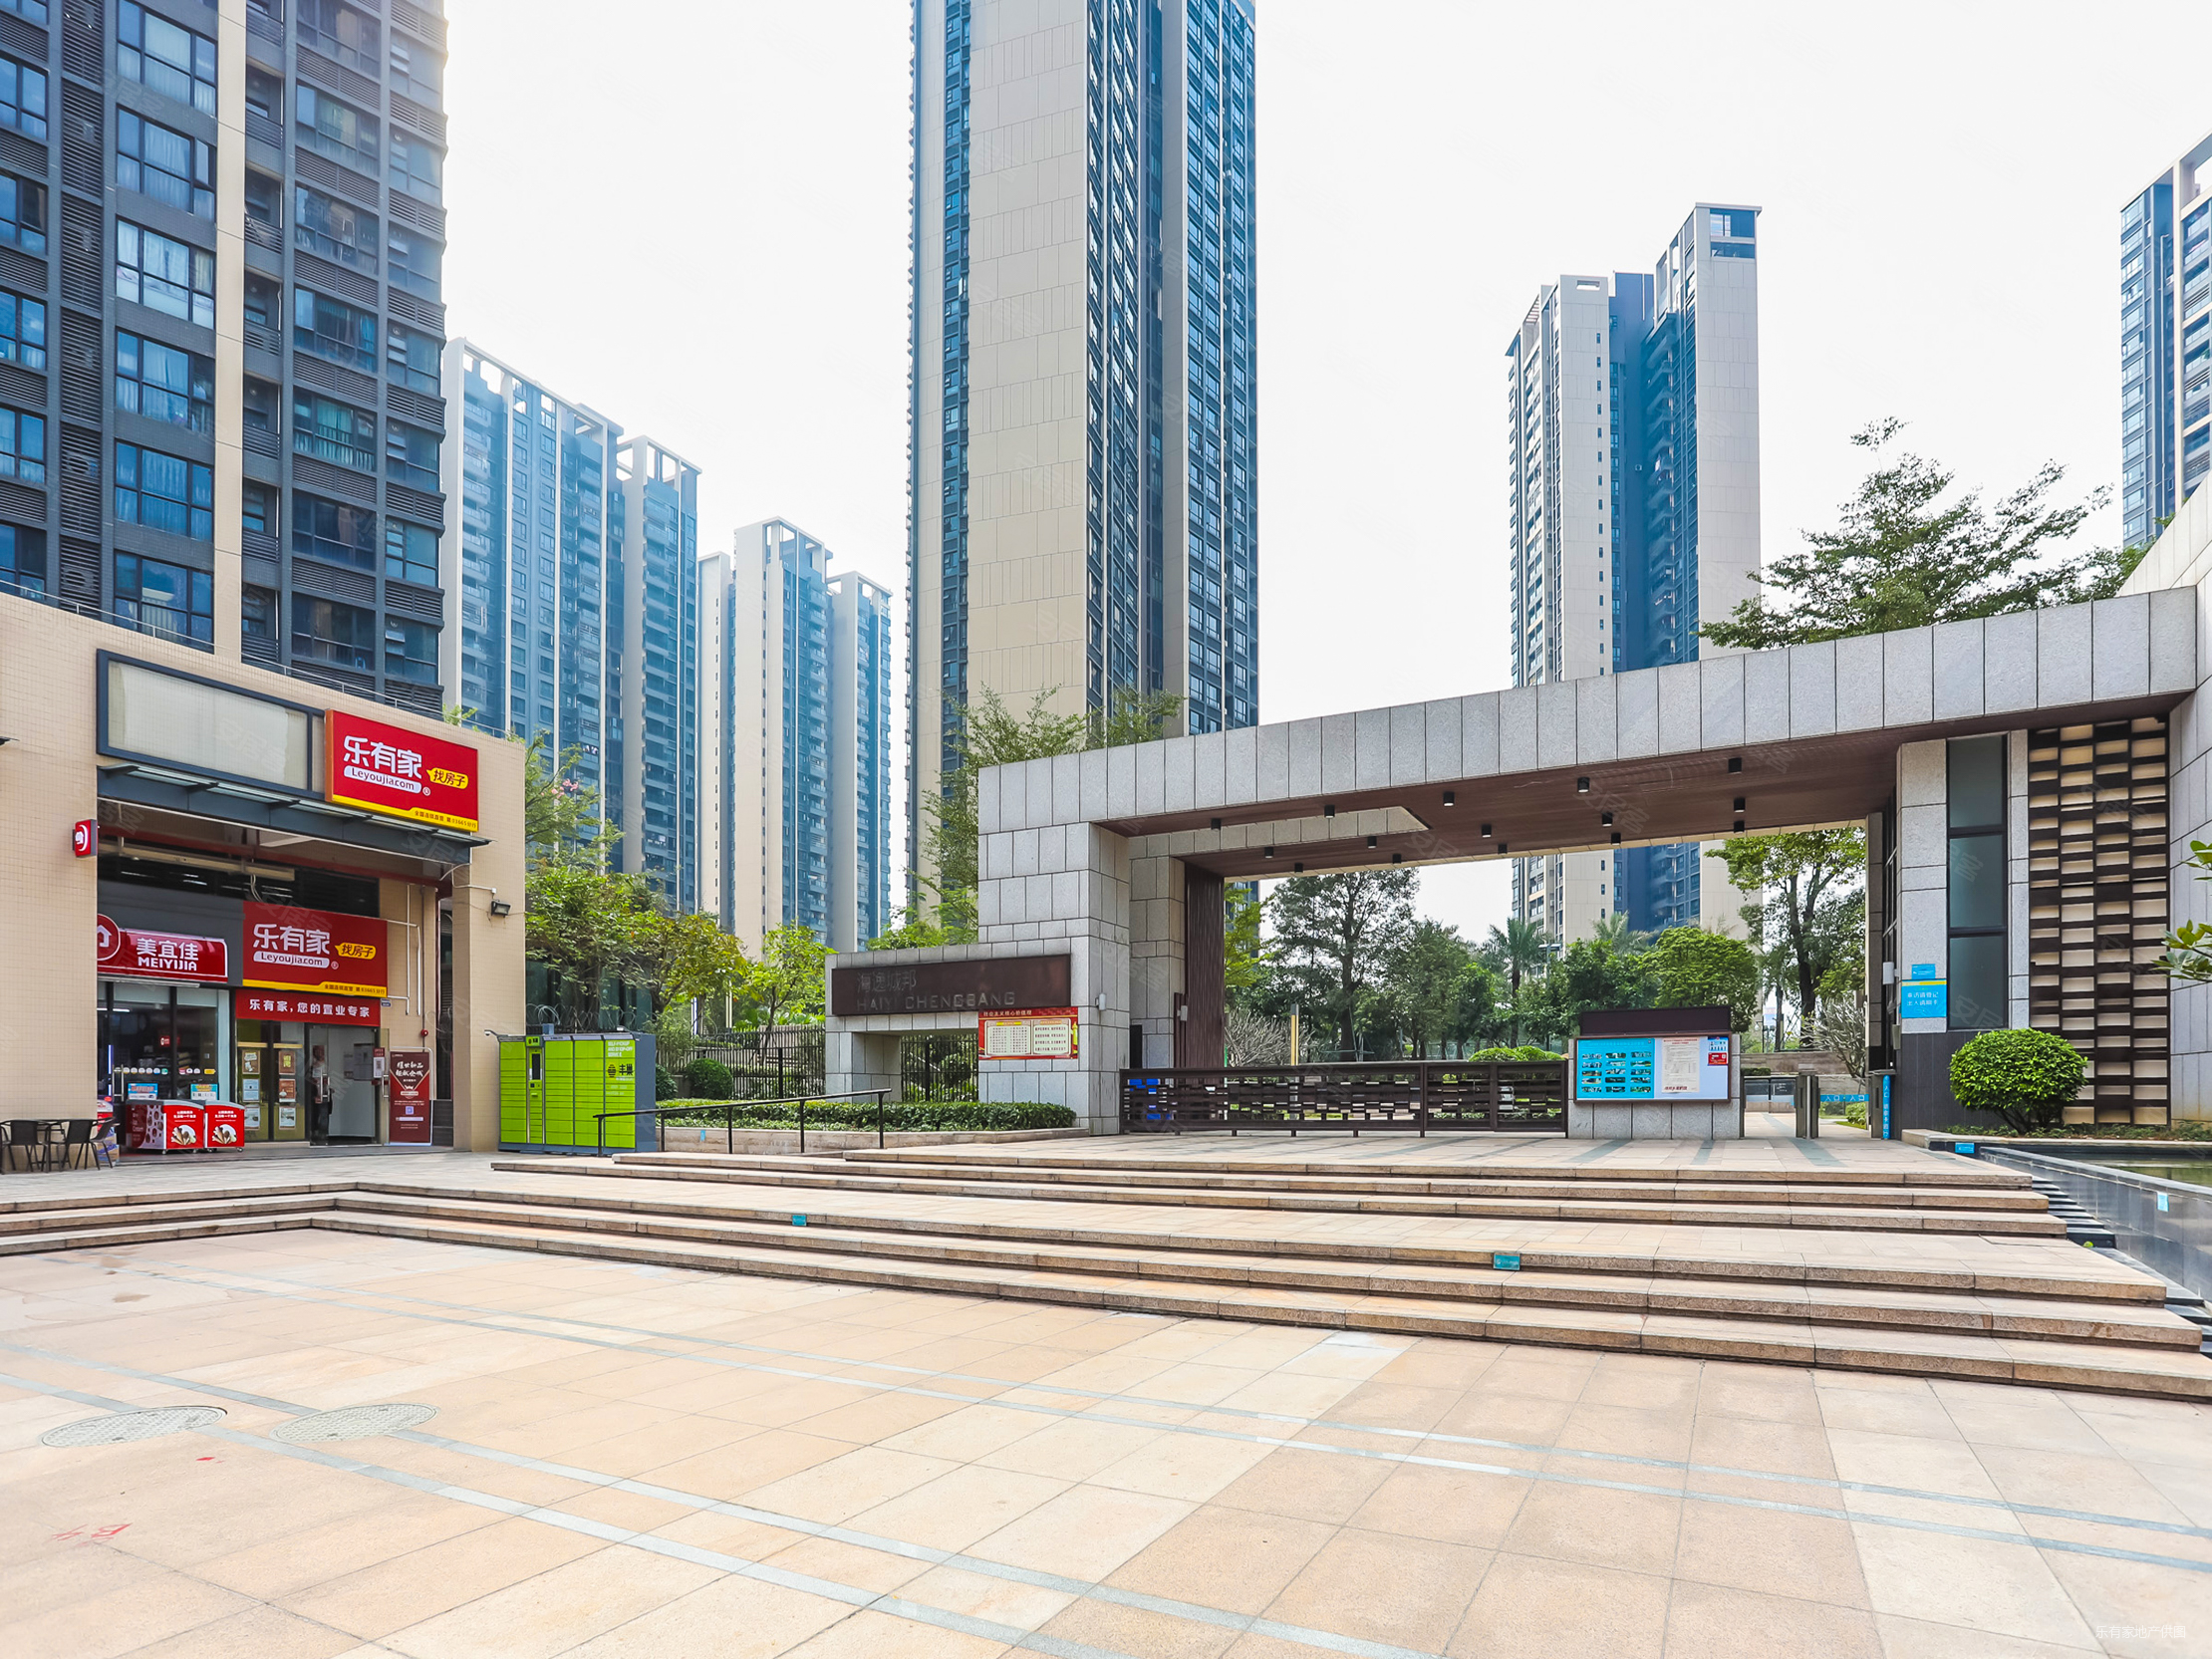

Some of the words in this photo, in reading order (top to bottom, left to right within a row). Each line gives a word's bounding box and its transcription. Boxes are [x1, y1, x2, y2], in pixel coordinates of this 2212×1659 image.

[343, 735, 422, 779] 乐有家
[433, 769, 465, 787] 找房子
[137, 937, 199, 961] 美宜佳
[253, 923, 331, 955] 乐有家
[341, 944, 374, 958] 找房子
[138, 957, 197, 971] MEIYIJIA
